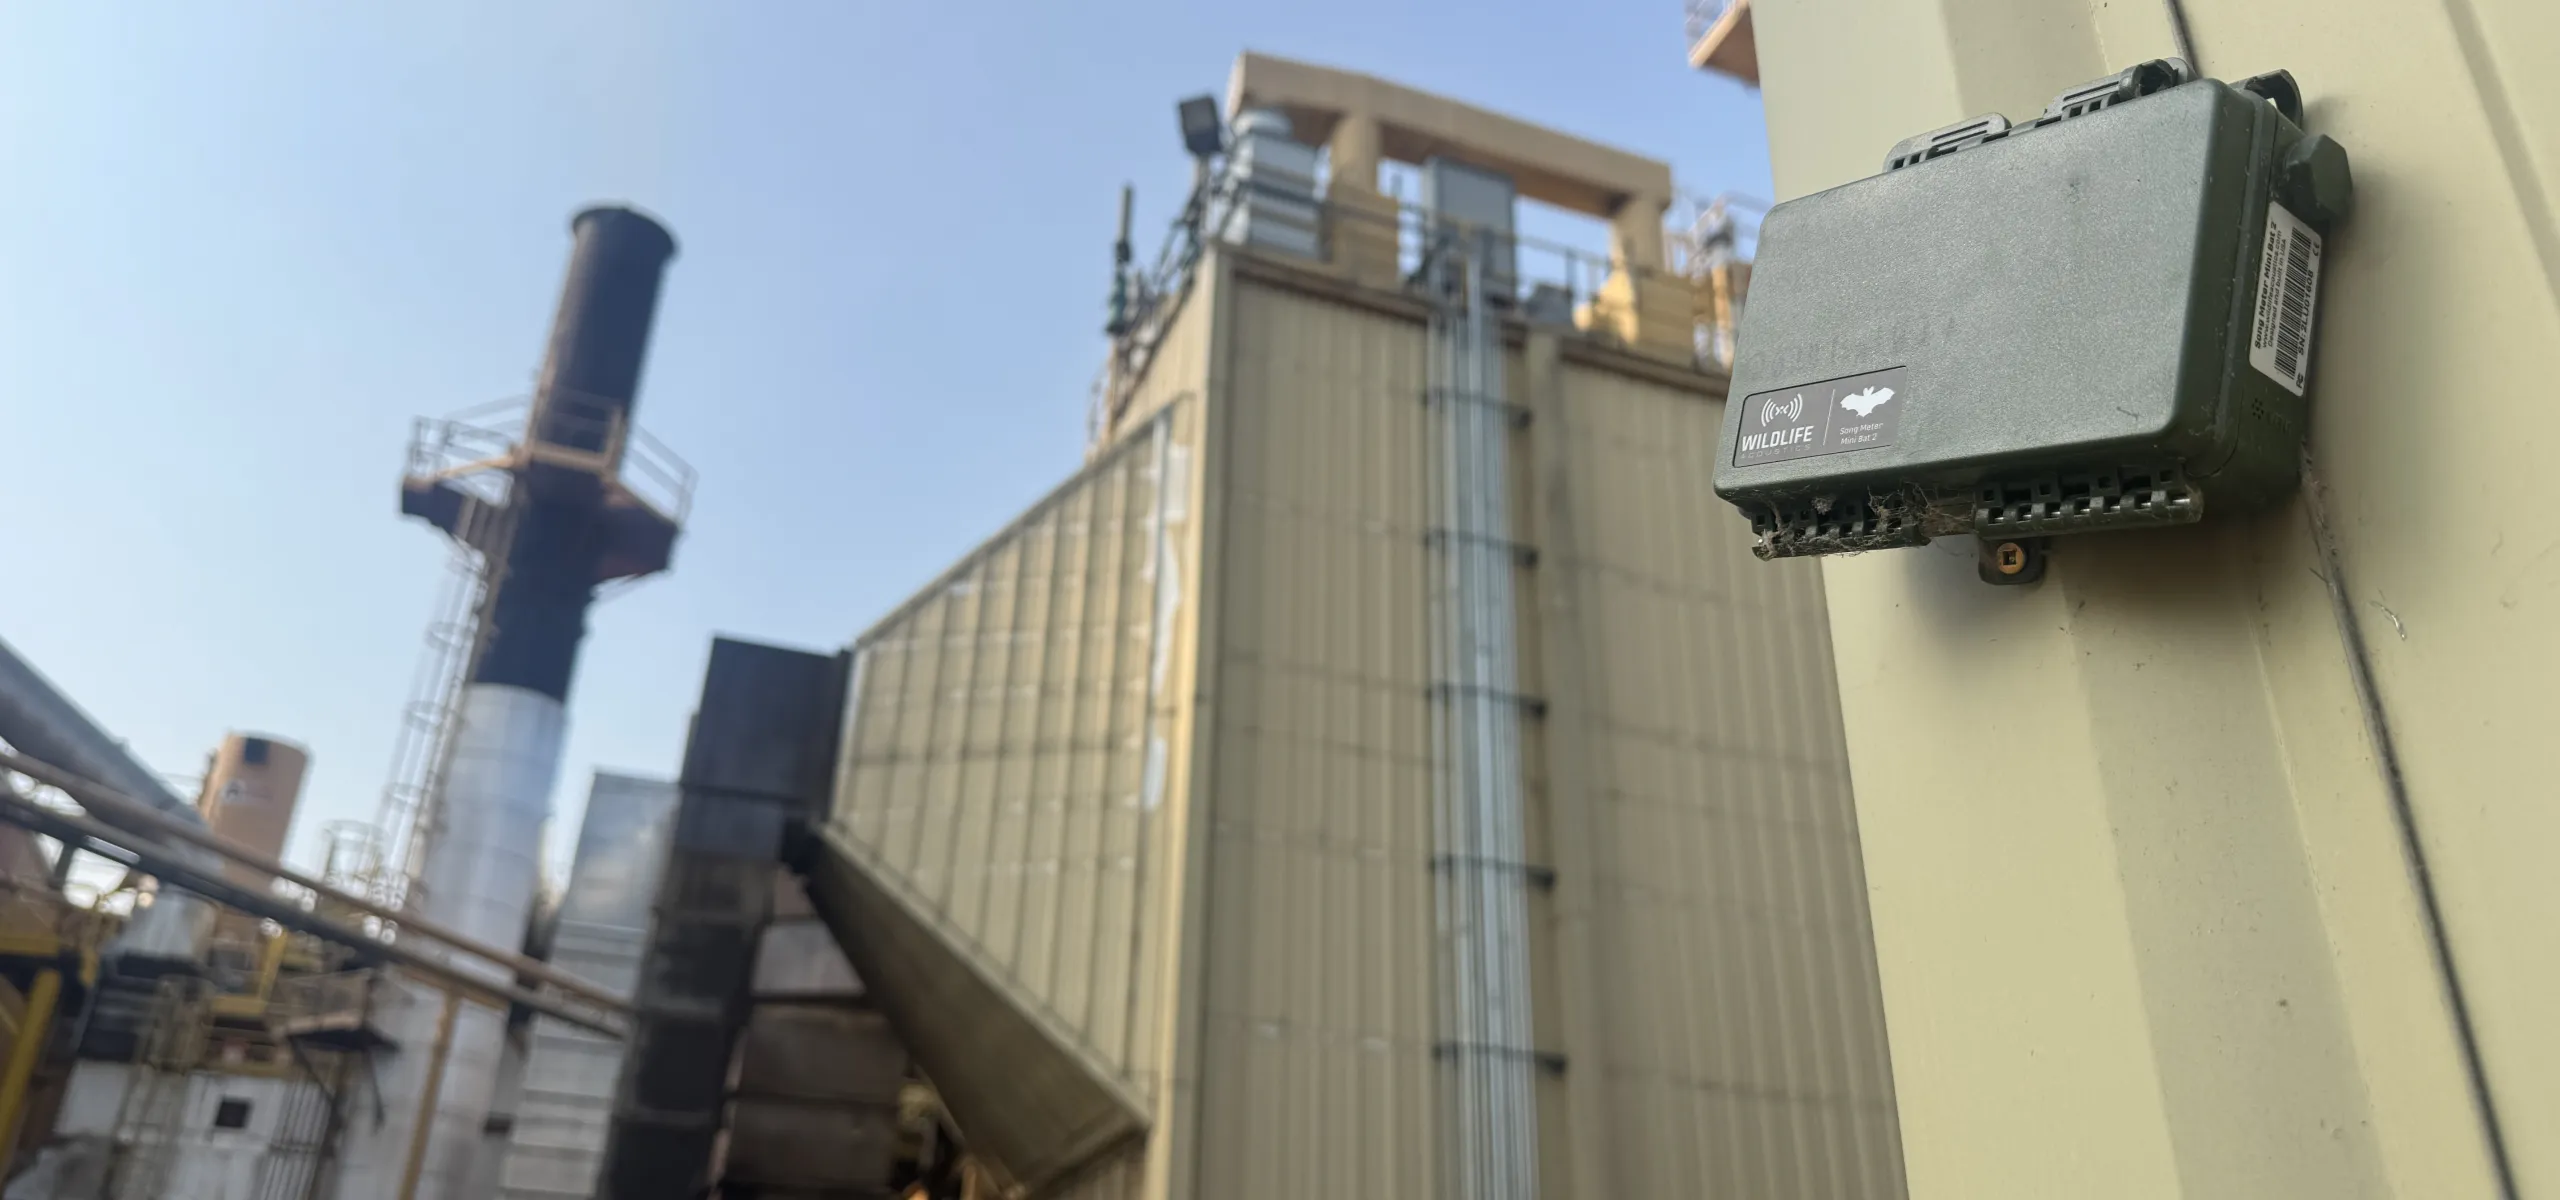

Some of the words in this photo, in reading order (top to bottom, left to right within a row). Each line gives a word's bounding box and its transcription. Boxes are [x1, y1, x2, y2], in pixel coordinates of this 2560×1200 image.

[2271, 221, 2277, 230] 2
[2268, 231, 2276, 252] Bat
[2264, 253, 2273, 279] Mini
[2259, 280, 2269, 317] Meter
[2255, 319, 2265, 349] Song
[1742, 425, 1815, 452] WILDLIFE
[1840, 426, 1859, 435] Song
[1860, 422, 1884, 432] Meter
[1840, 436, 1857, 445] Mini
[1858, 434, 1871, 443] Bat
[1872, 432, 1878, 441] 2
